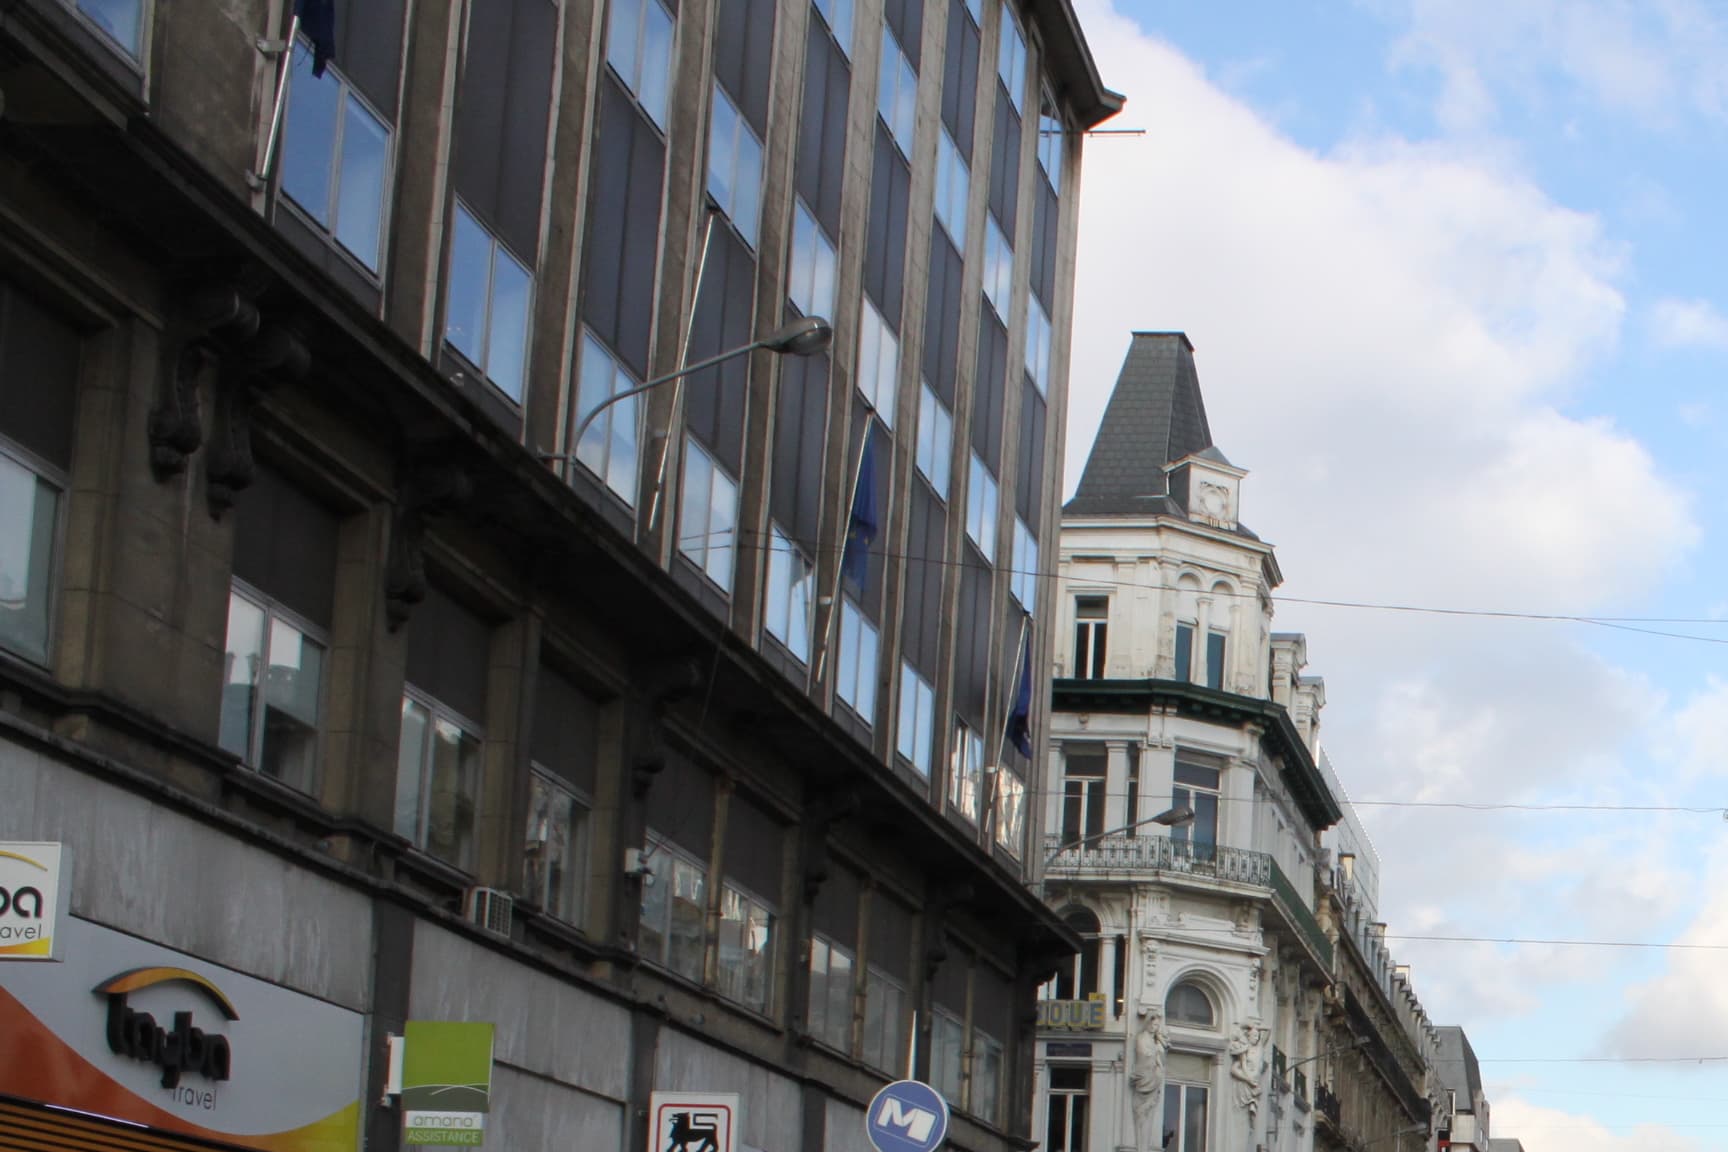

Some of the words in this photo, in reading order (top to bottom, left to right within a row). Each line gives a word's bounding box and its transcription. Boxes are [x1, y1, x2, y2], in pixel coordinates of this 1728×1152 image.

[0, 924, 42, 940] avel
[877, 1097, 937, 1143] M
[407, 1130, 480, 1144] ASSISTANCE
